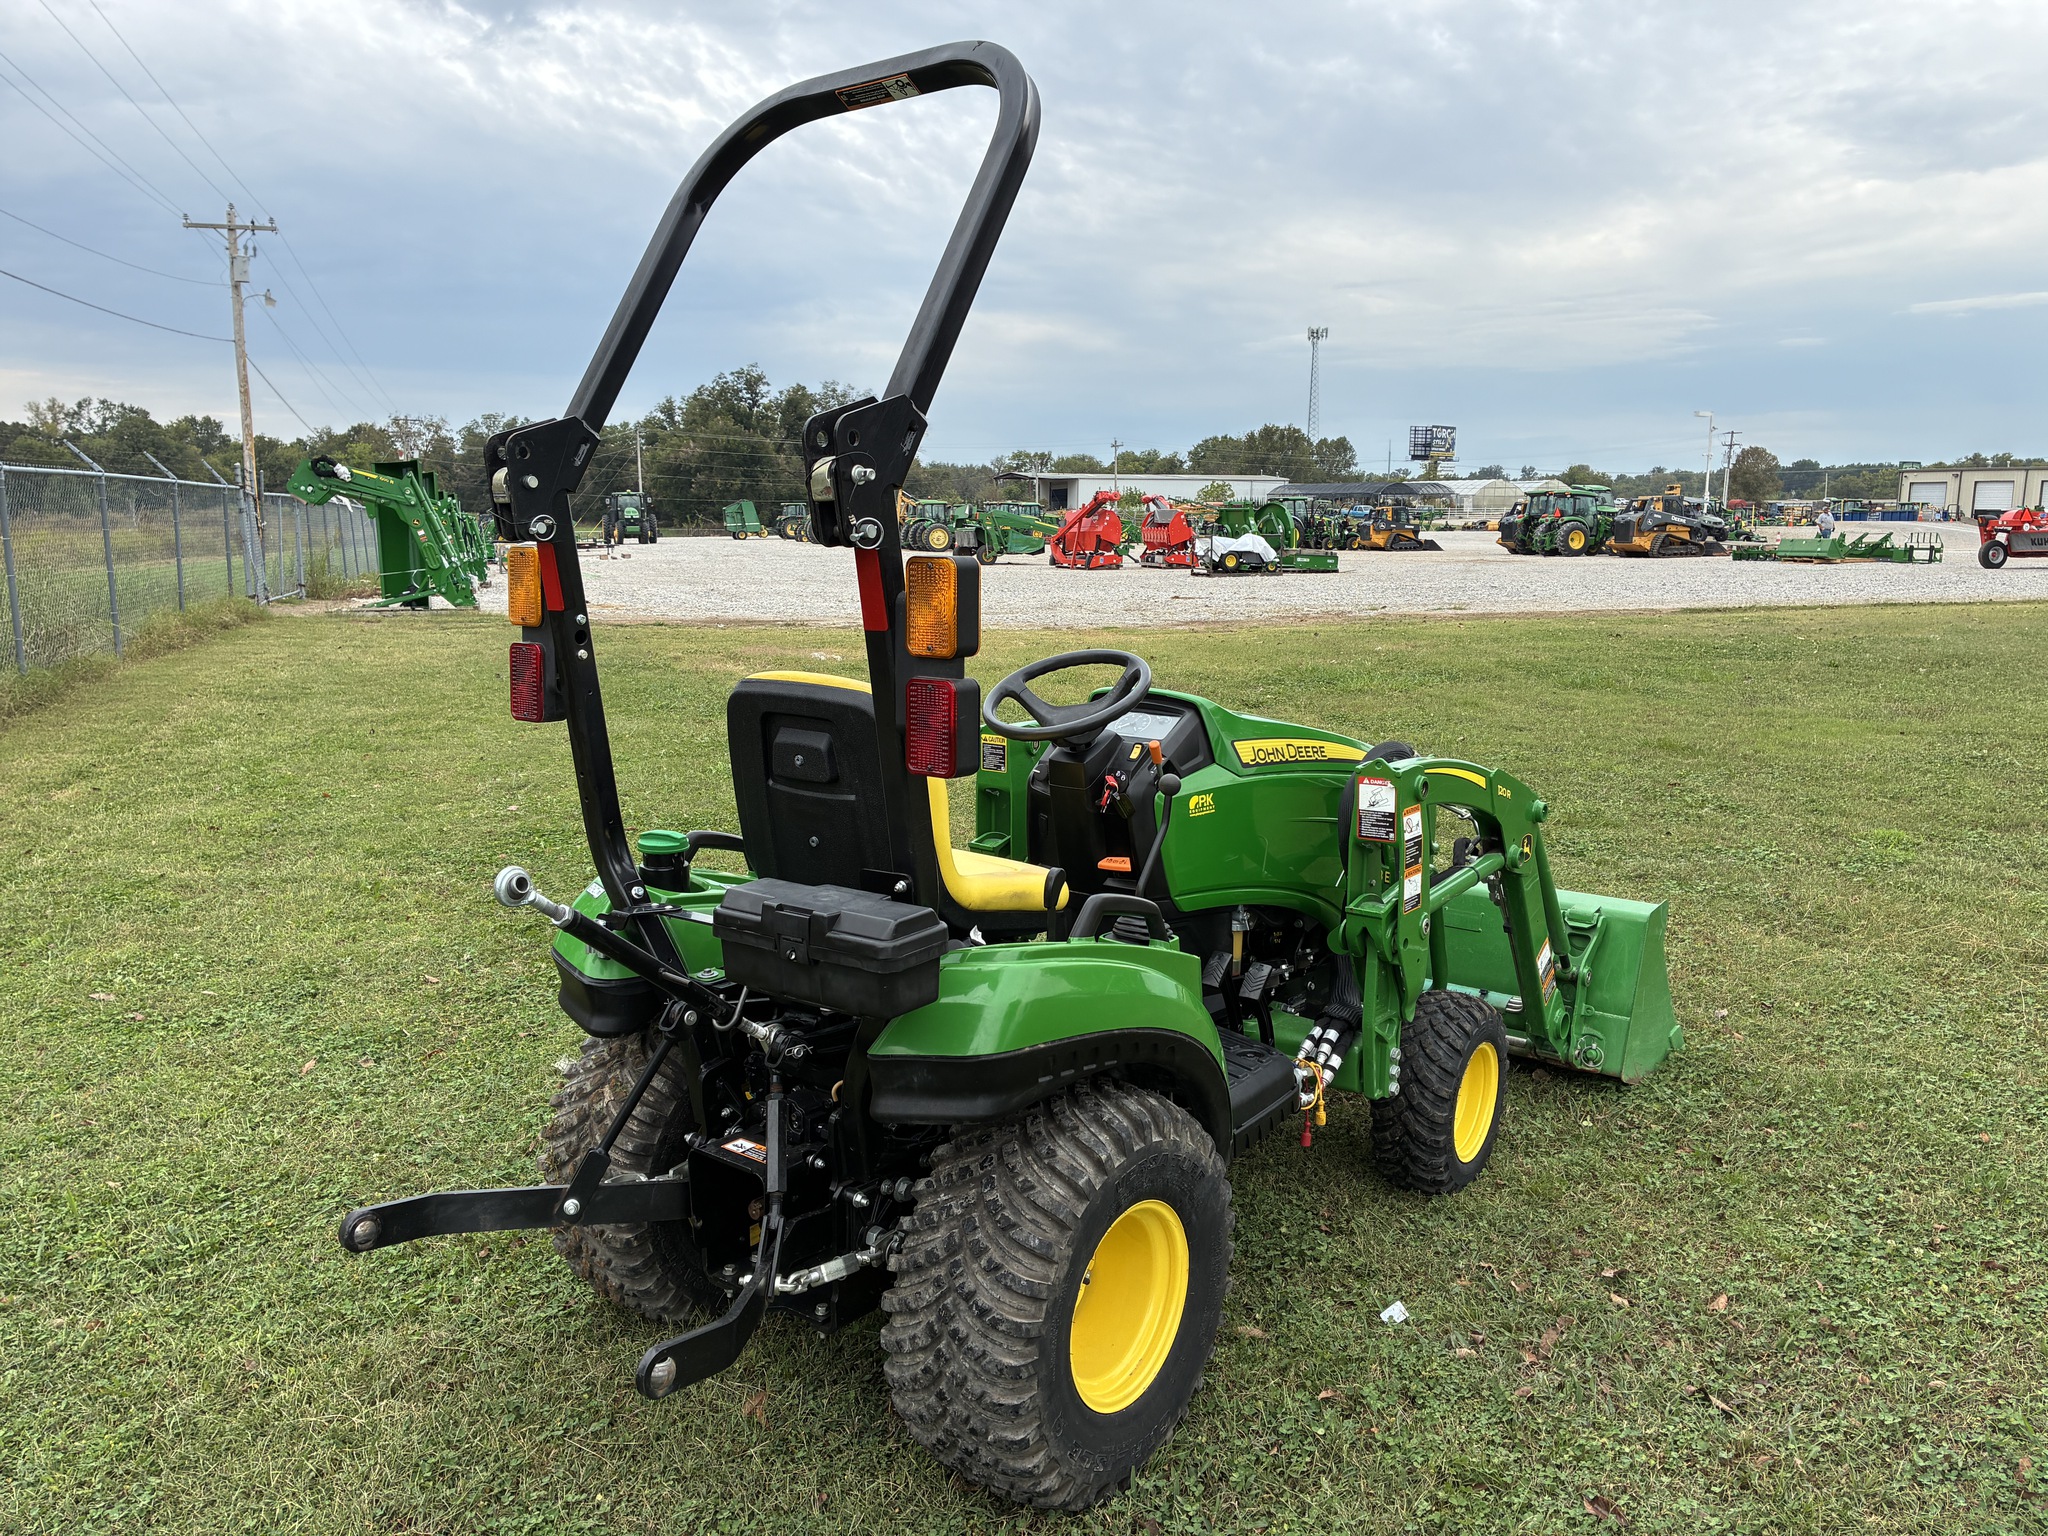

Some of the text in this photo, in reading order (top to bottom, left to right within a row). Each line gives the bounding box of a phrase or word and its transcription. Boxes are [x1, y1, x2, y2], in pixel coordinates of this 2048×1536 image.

[1671, 515, 1687, 524] DEERE
[988, 736, 1006, 744] CAUTION
[1250, 743, 1328, 763] JOHN DEERE
